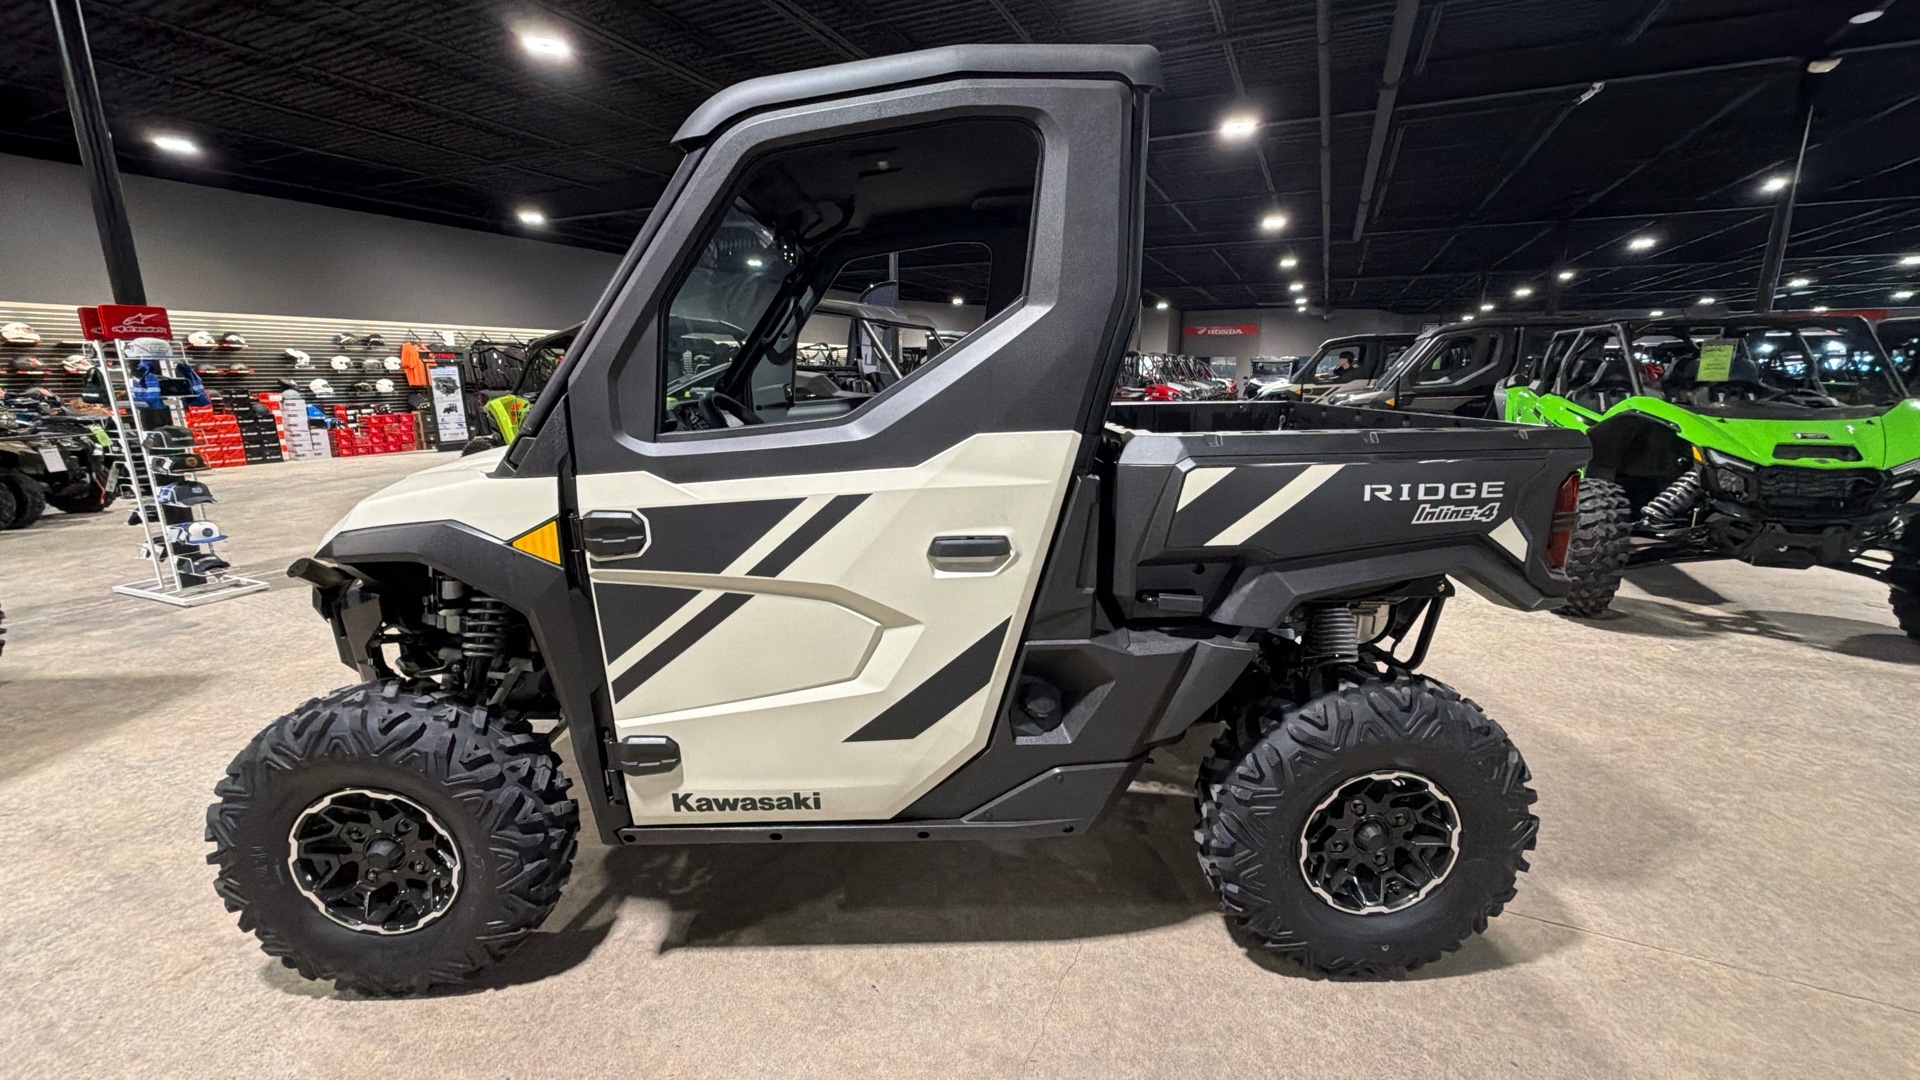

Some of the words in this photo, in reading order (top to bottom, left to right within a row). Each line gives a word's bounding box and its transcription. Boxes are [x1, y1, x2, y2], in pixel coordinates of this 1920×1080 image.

[1363, 481, 1505, 501] RIDGE
[1411, 502, 1500, 524] Inline-4
[671, 792, 821, 812] Kawasaki
